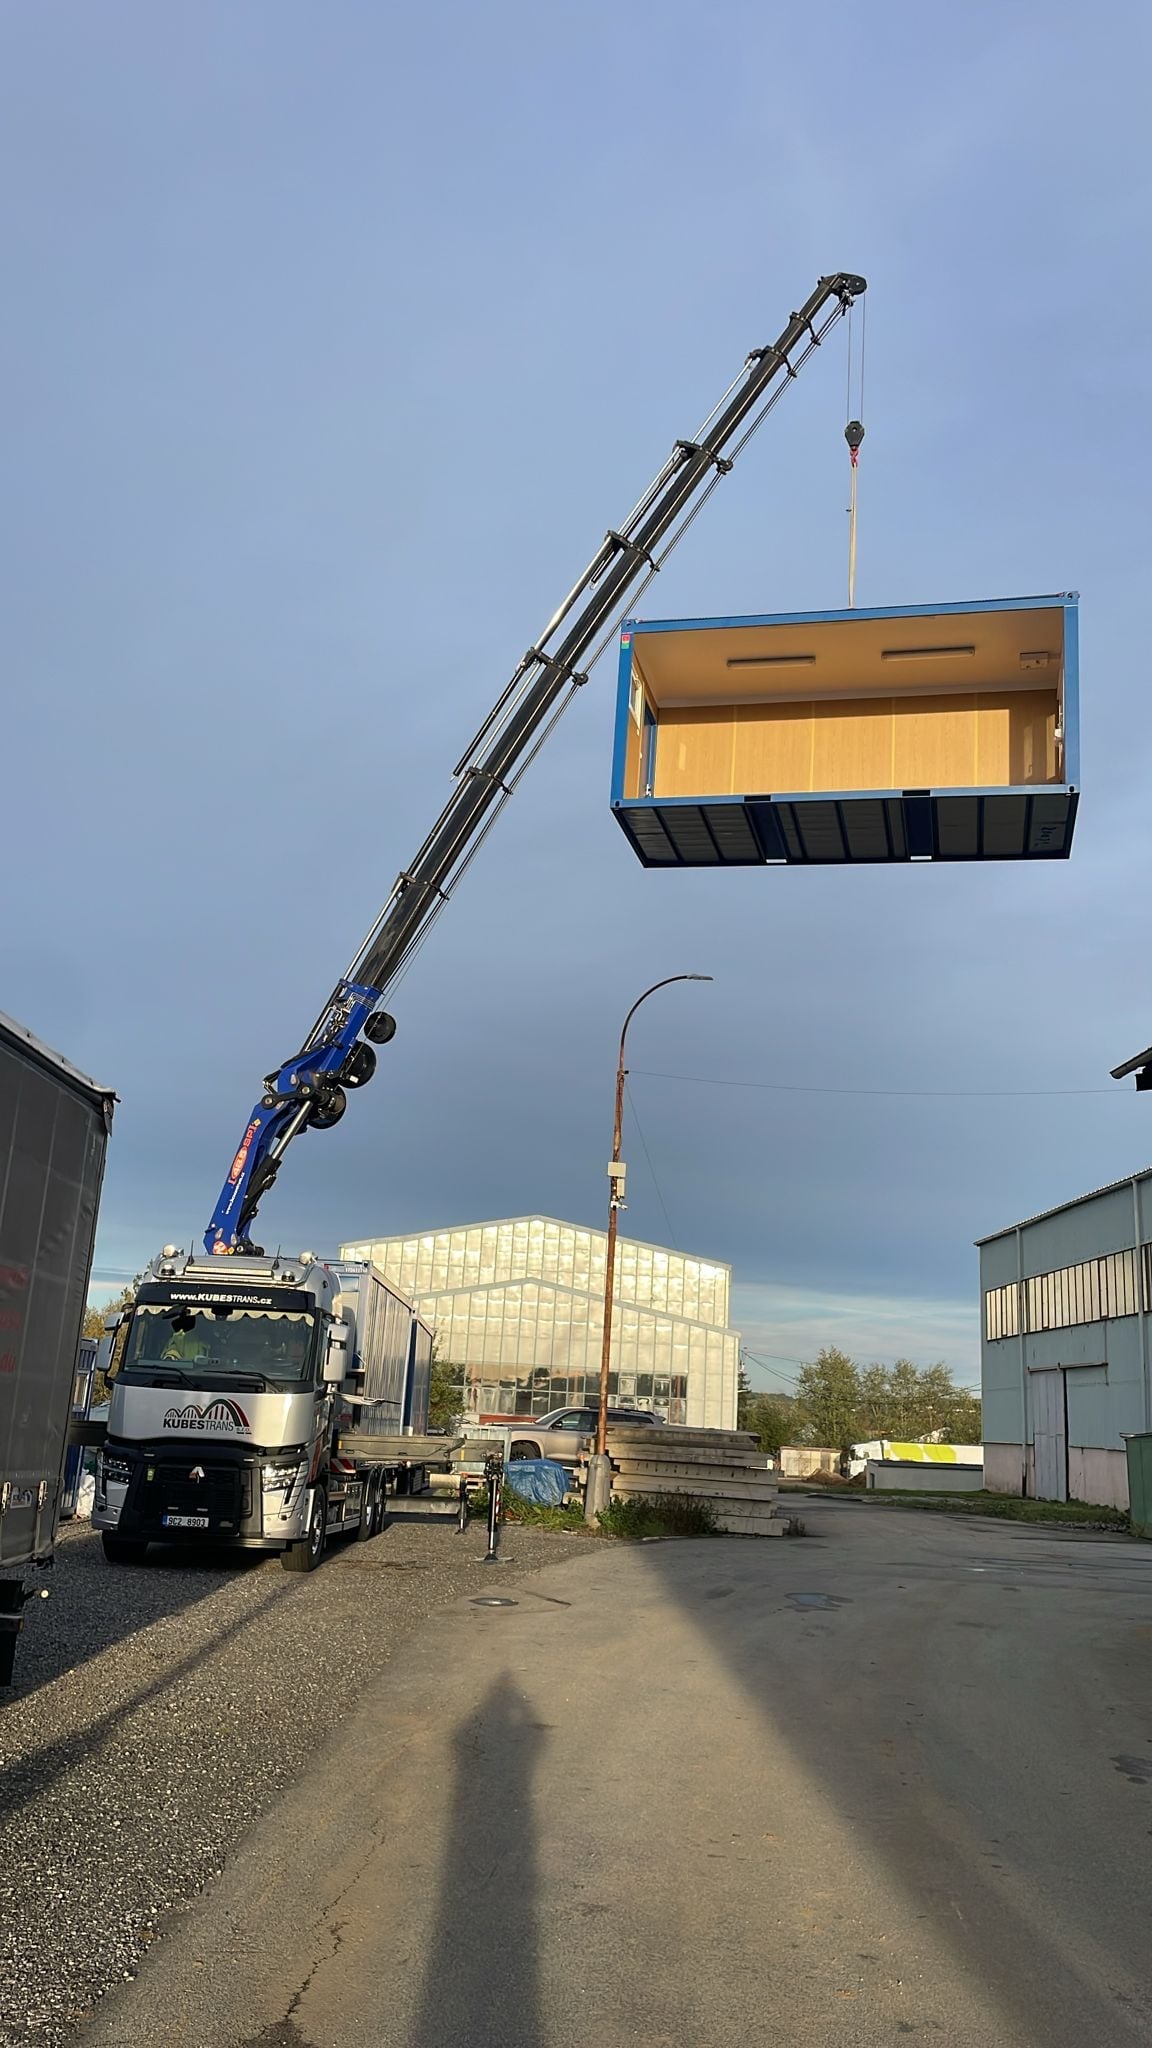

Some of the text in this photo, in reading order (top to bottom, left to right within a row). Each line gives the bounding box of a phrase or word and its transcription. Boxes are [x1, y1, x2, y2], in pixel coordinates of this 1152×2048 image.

[170, 1293, 273, 1304] www.KUBESTRANS.cz
[163, 1418, 234, 1432] KUBESTRANS
[187, 1518, 206, 1527] 8903
